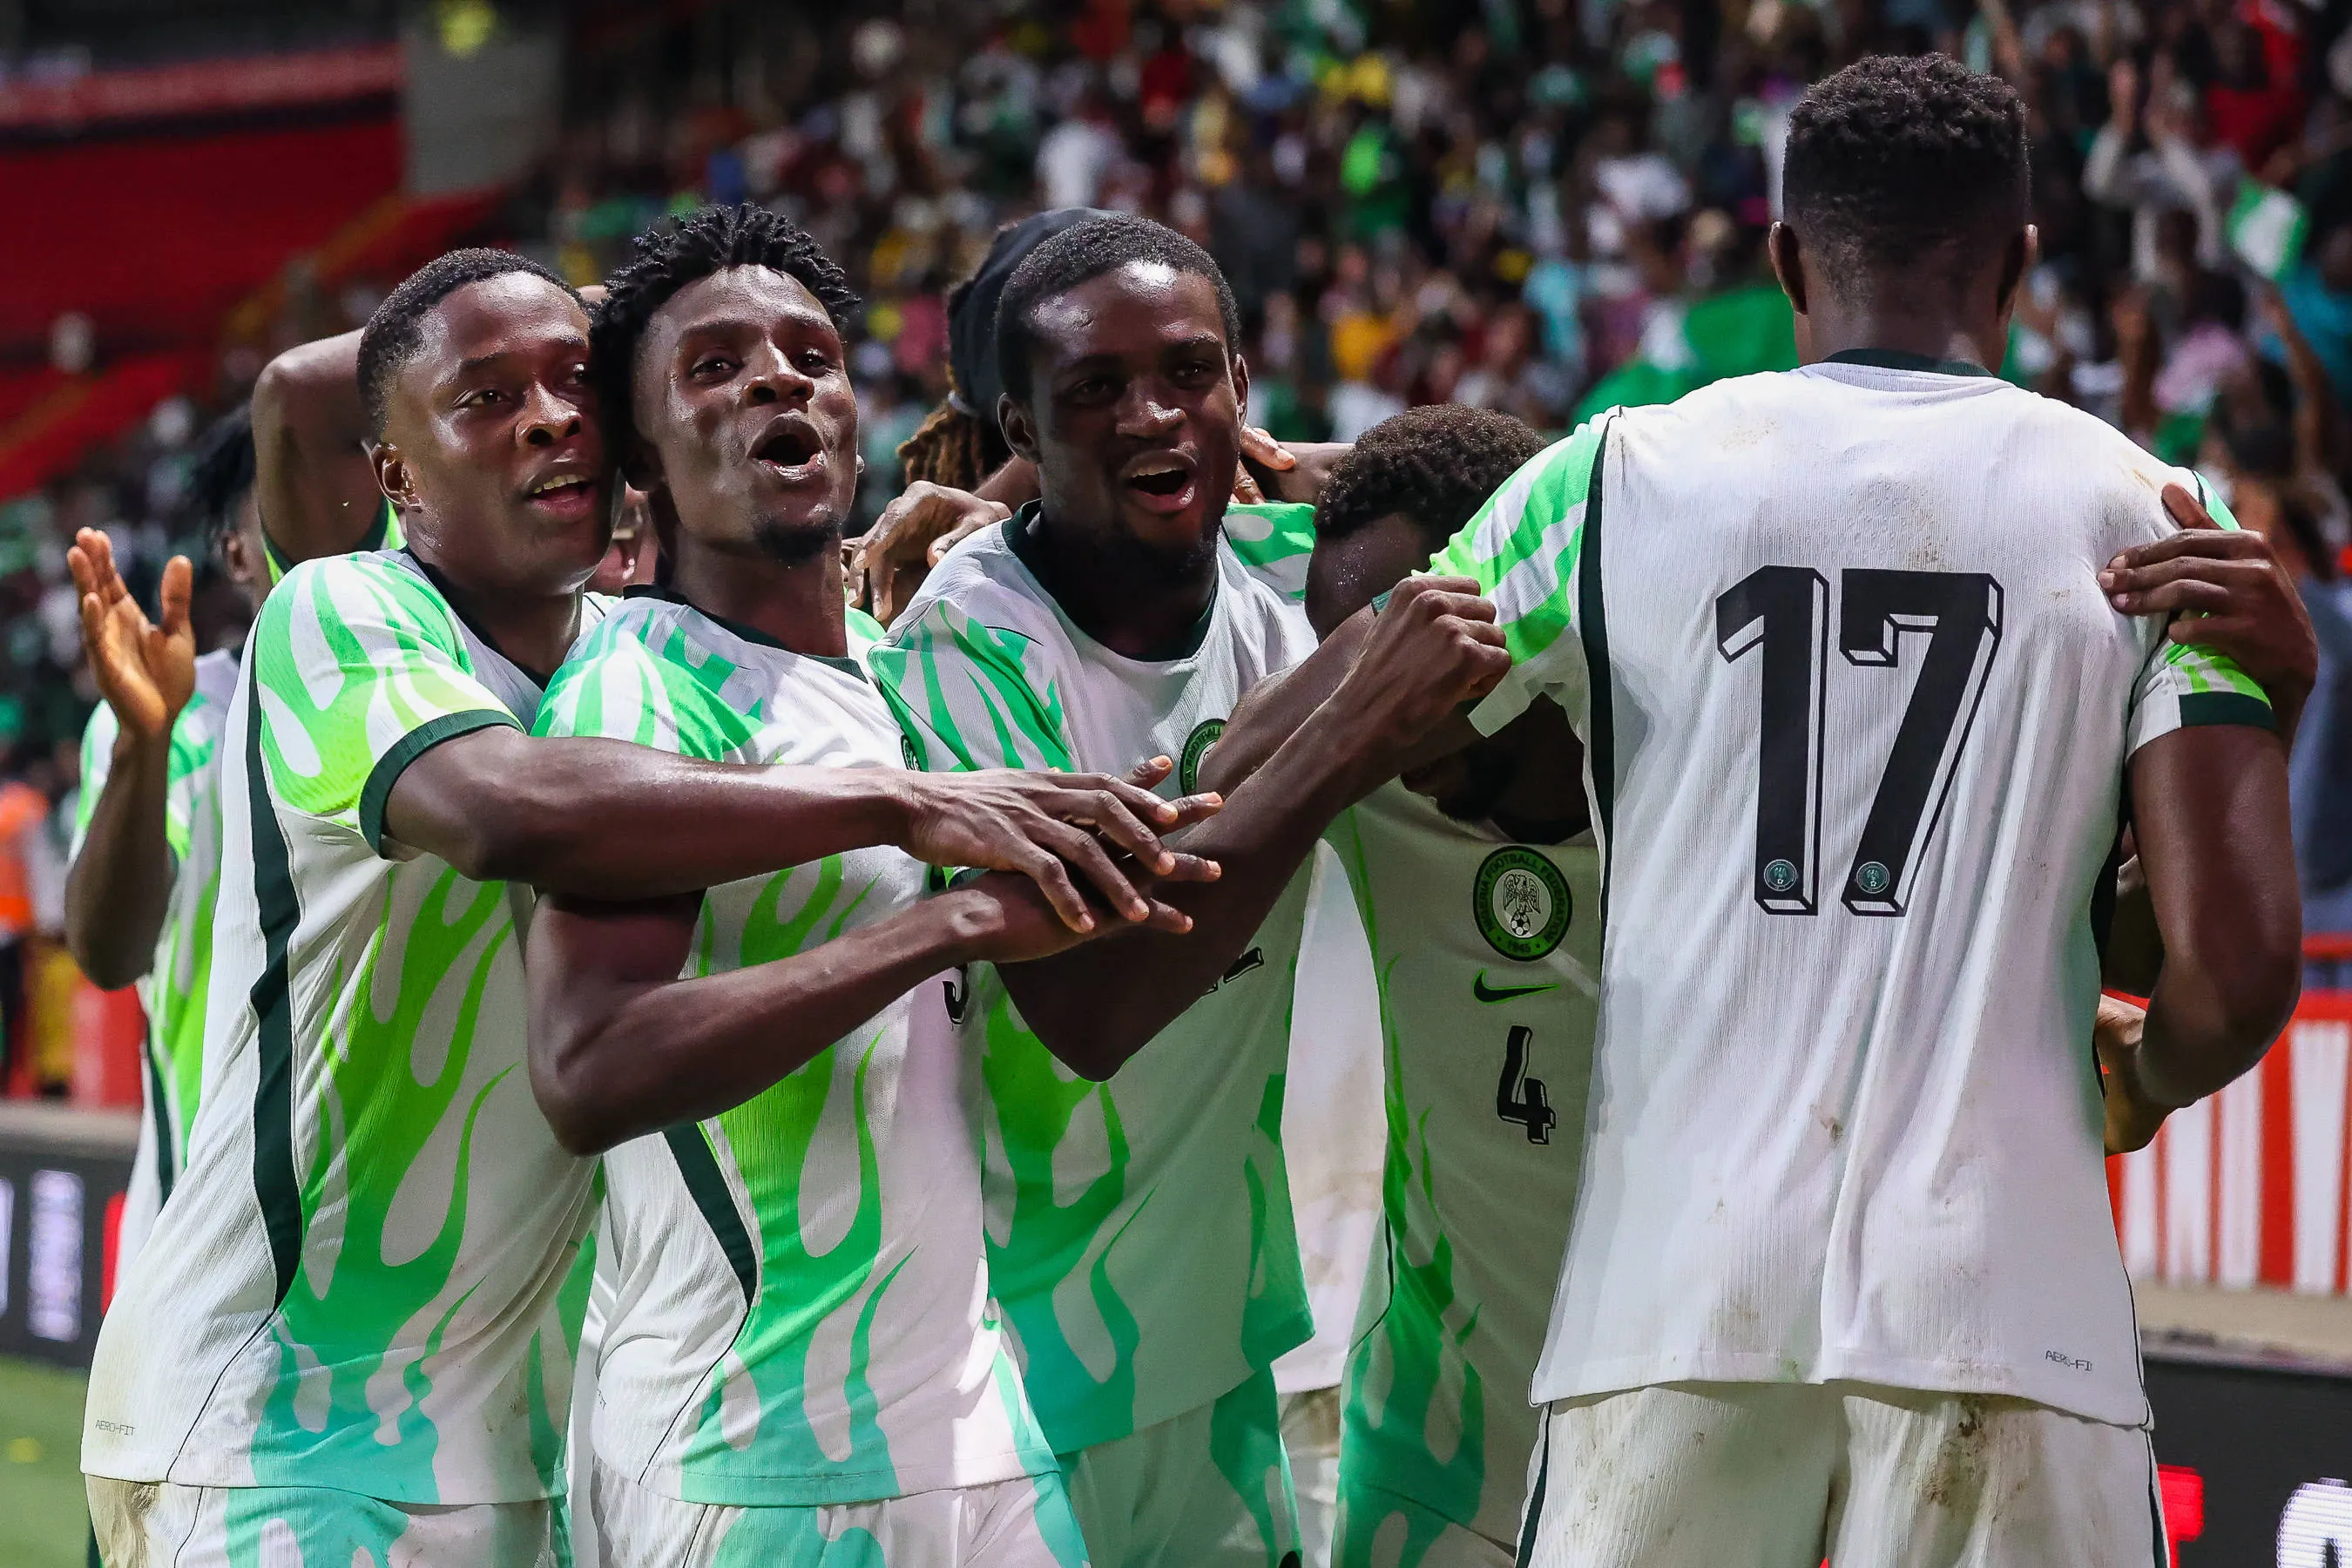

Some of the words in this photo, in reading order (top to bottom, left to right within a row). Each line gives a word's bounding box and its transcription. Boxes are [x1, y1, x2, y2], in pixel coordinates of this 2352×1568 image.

[1716, 565, 2004, 916] 17
[1496, 1024, 1557, 1145] 4
[95, 1420, 136, 1436] AERO-FIT
